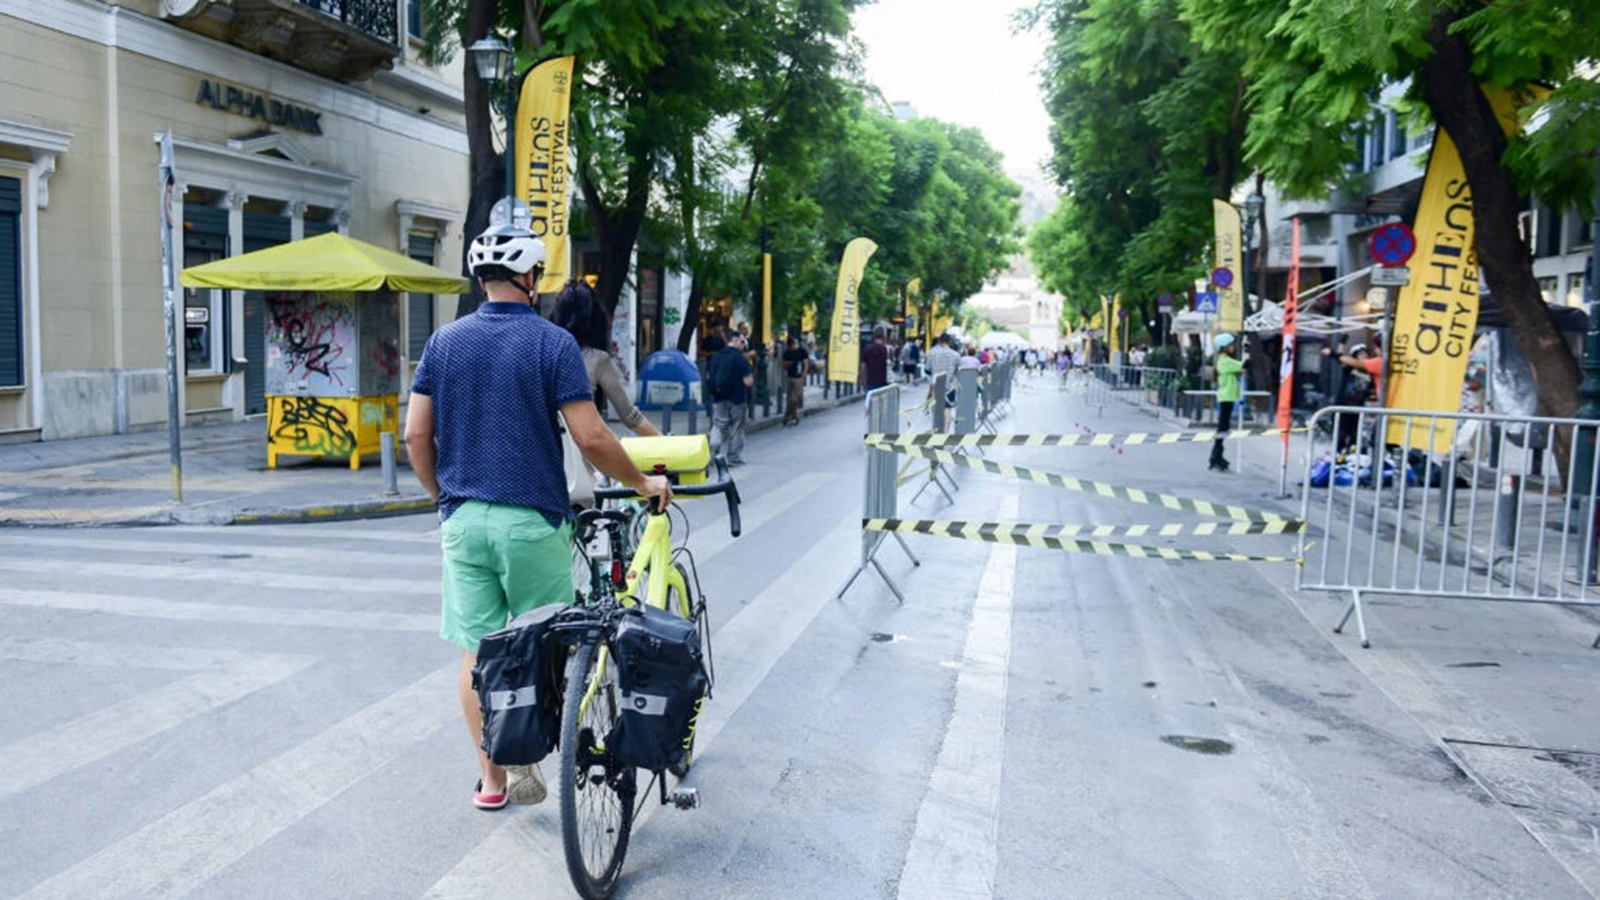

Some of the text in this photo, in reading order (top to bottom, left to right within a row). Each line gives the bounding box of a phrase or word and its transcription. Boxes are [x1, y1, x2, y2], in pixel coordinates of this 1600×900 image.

[196, 79, 323, 135] ALPHA BANK
[551, 120, 565, 236] CITY FESTIVAL
[1445, 302, 1471, 358] CITY
[1405, 358, 1418, 375] IS
